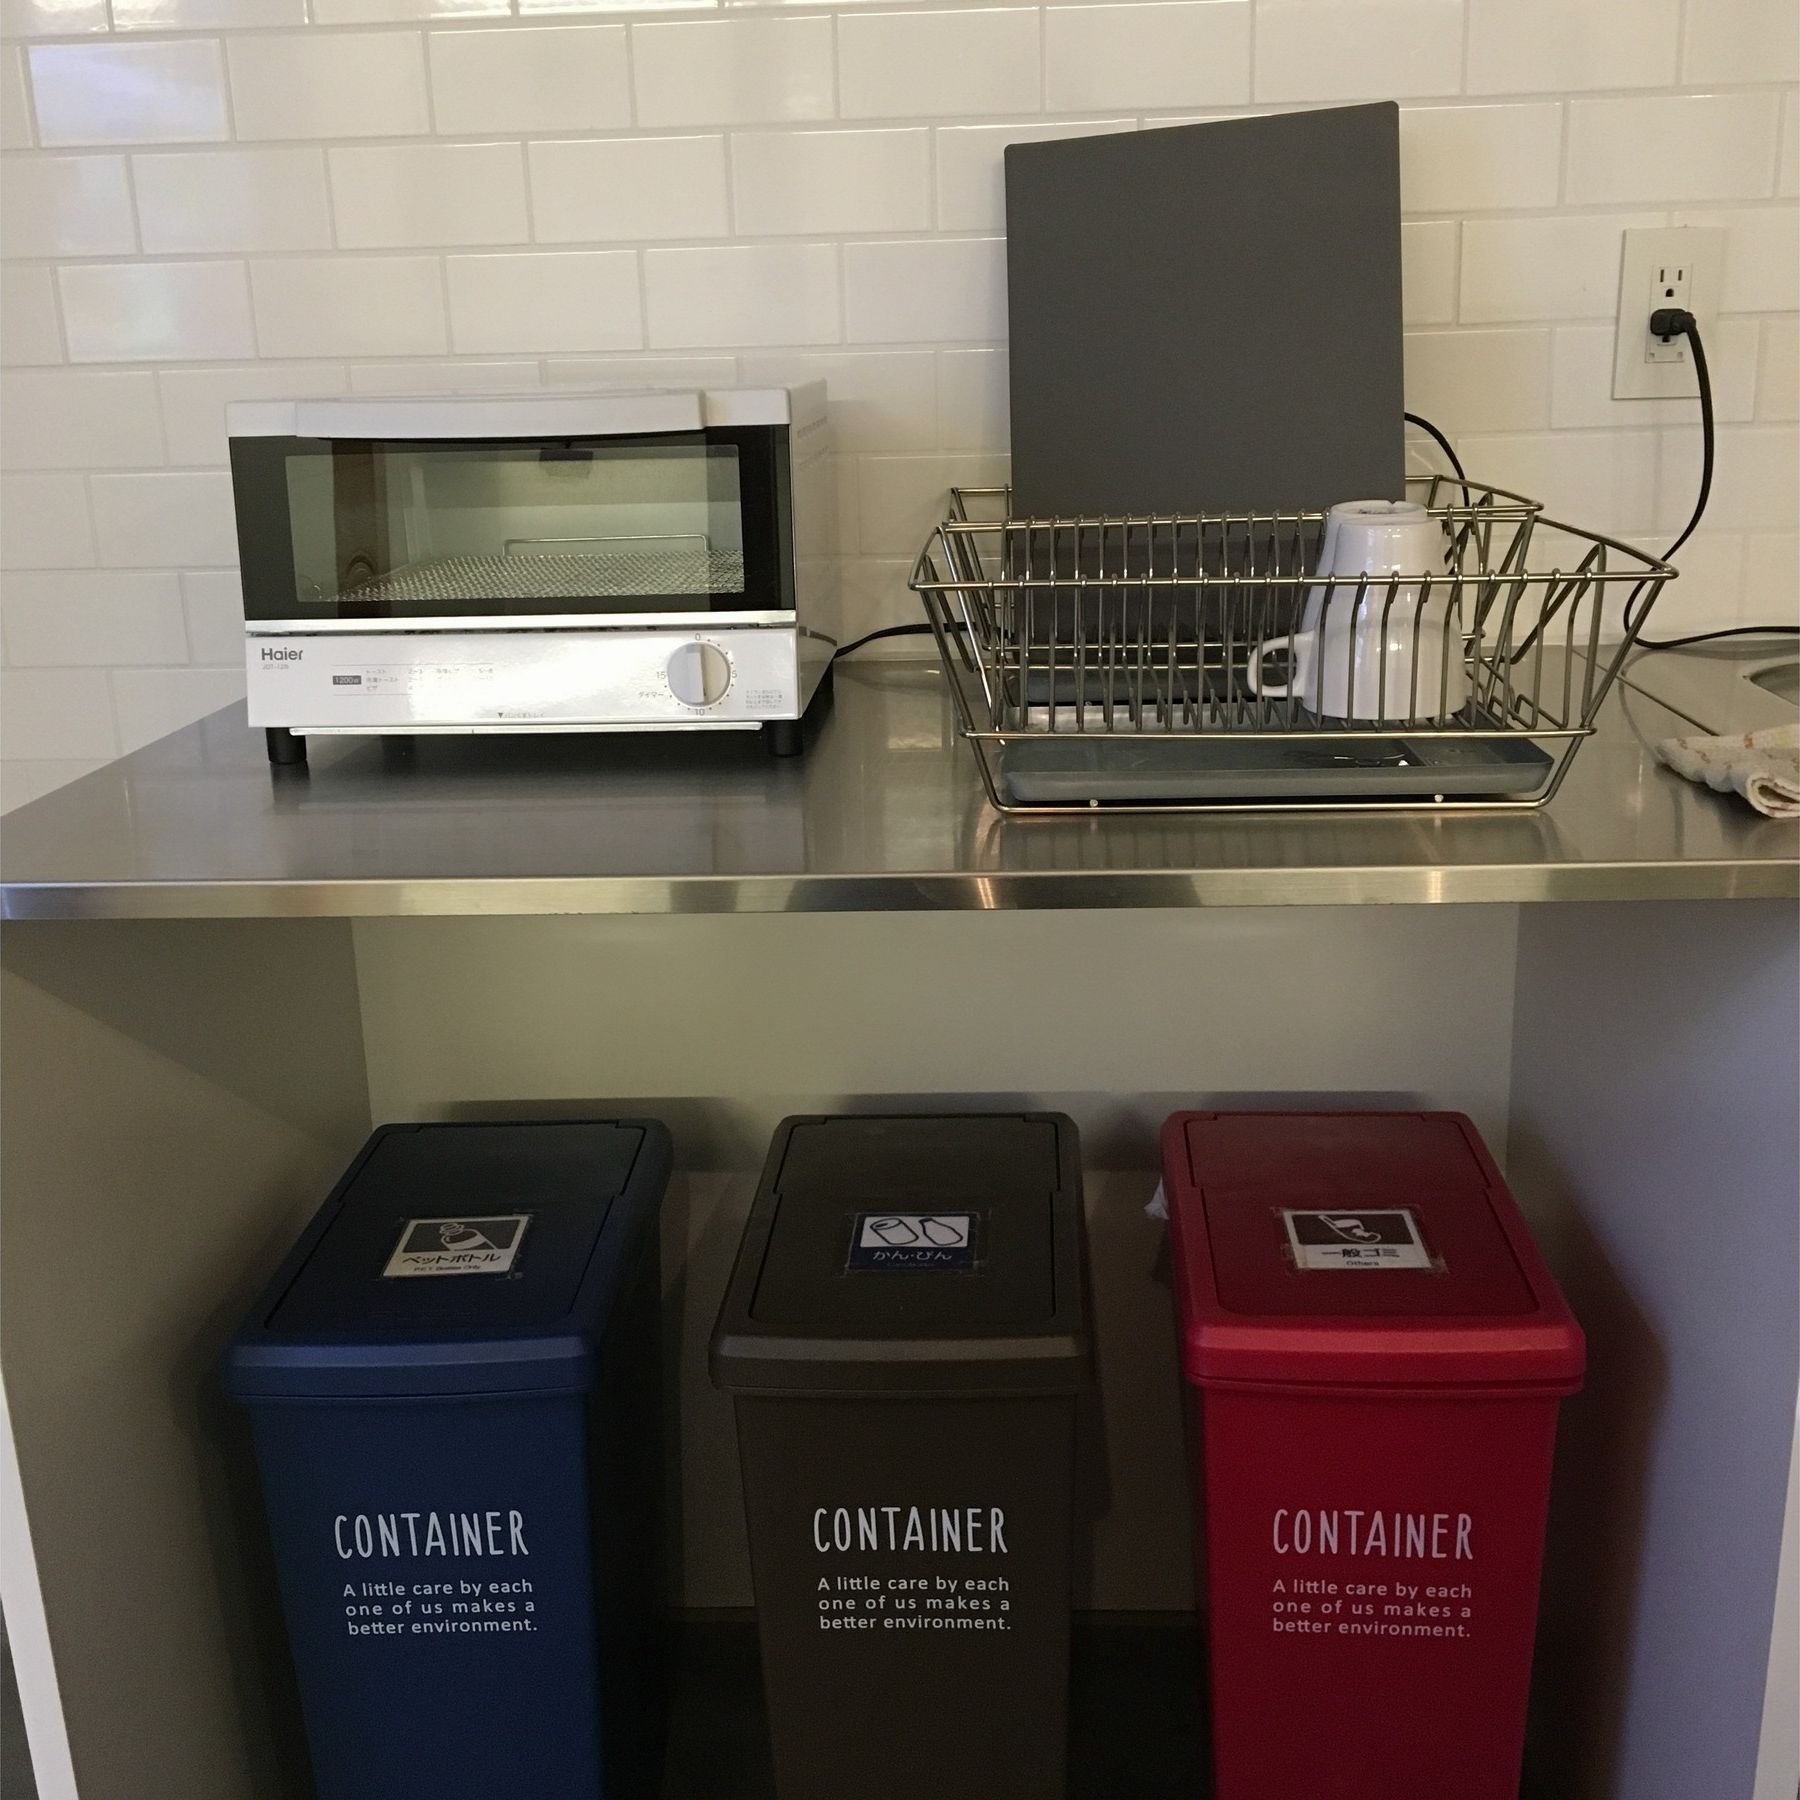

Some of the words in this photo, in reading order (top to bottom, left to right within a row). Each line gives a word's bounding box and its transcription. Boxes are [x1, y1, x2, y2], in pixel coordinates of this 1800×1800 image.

[695, 633, 700, 641] 0
[261, 647, 303, 661] Haier
[656, 671, 666, 680] 15
[732, 670, 737, 678] 5
[695, 708, 705, 716] 10
[402, 1254, 501, 1265] ペットボトル
[335, 1510, 529, 1559] CONTAINER
[814, 1506, 1008, 1553] CONTAINER
[1273, 1509, 1473, 1560] CONTAINER
[344, 1584, 356, 1597] A
[363, 1582, 405, 1596] little
[413, 1584, 453, 1595] care
[460, 1580, 481, 1596] by
[489, 1579, 532, 1593] each
[818, 1578, 830, 1590] A
[838, 1577, 880, 1590] little
[888, 1579, 928, 1589] care
[936, 1577, 958, 1592] by
[965, 1577, 1009, 1591] each
[1273, 1579, 1286, 1593] A
[1293, 1579, 1338, 1594] little
[1346, 1583, 1387, 1595] care
[1396, 1582, 1418, 1599] by
[1426, 1585, 1471, 1598] each
[346, 1604, 382, 1616] one
[392, 1601, 412, 1614] of
[421, 1603, 442, 1614] us
[453, 1599, 515, 1613] makes
[525, 1601, 535, 1611] a
[819, 1599, 856, 1610] one
[866, 1595, 886, 1609] of
[895, 1599, 916, 1609] us
[927, 1596, 990, 1610] makes
[1000, 1601, 1010, 1610] a
[1273, 1602, 1311, 1613] one
[1321, 1600, 1342, 1613] of
[1352, 1604, 1373, 1615] us
[1384, 1602, 1451, 1617] makes
[1461, 1607, 1471, 1617] a
[348, 1621, 404, 1635] better
[412, 1619, 537, 1633] environment.
[820, 1616, 876, 1629] better
[884, 1615, 1011, 1629] environment.
[1273, 1618, 1331, 1632] better
[1339, 1621, 1471, 1637] environment.
